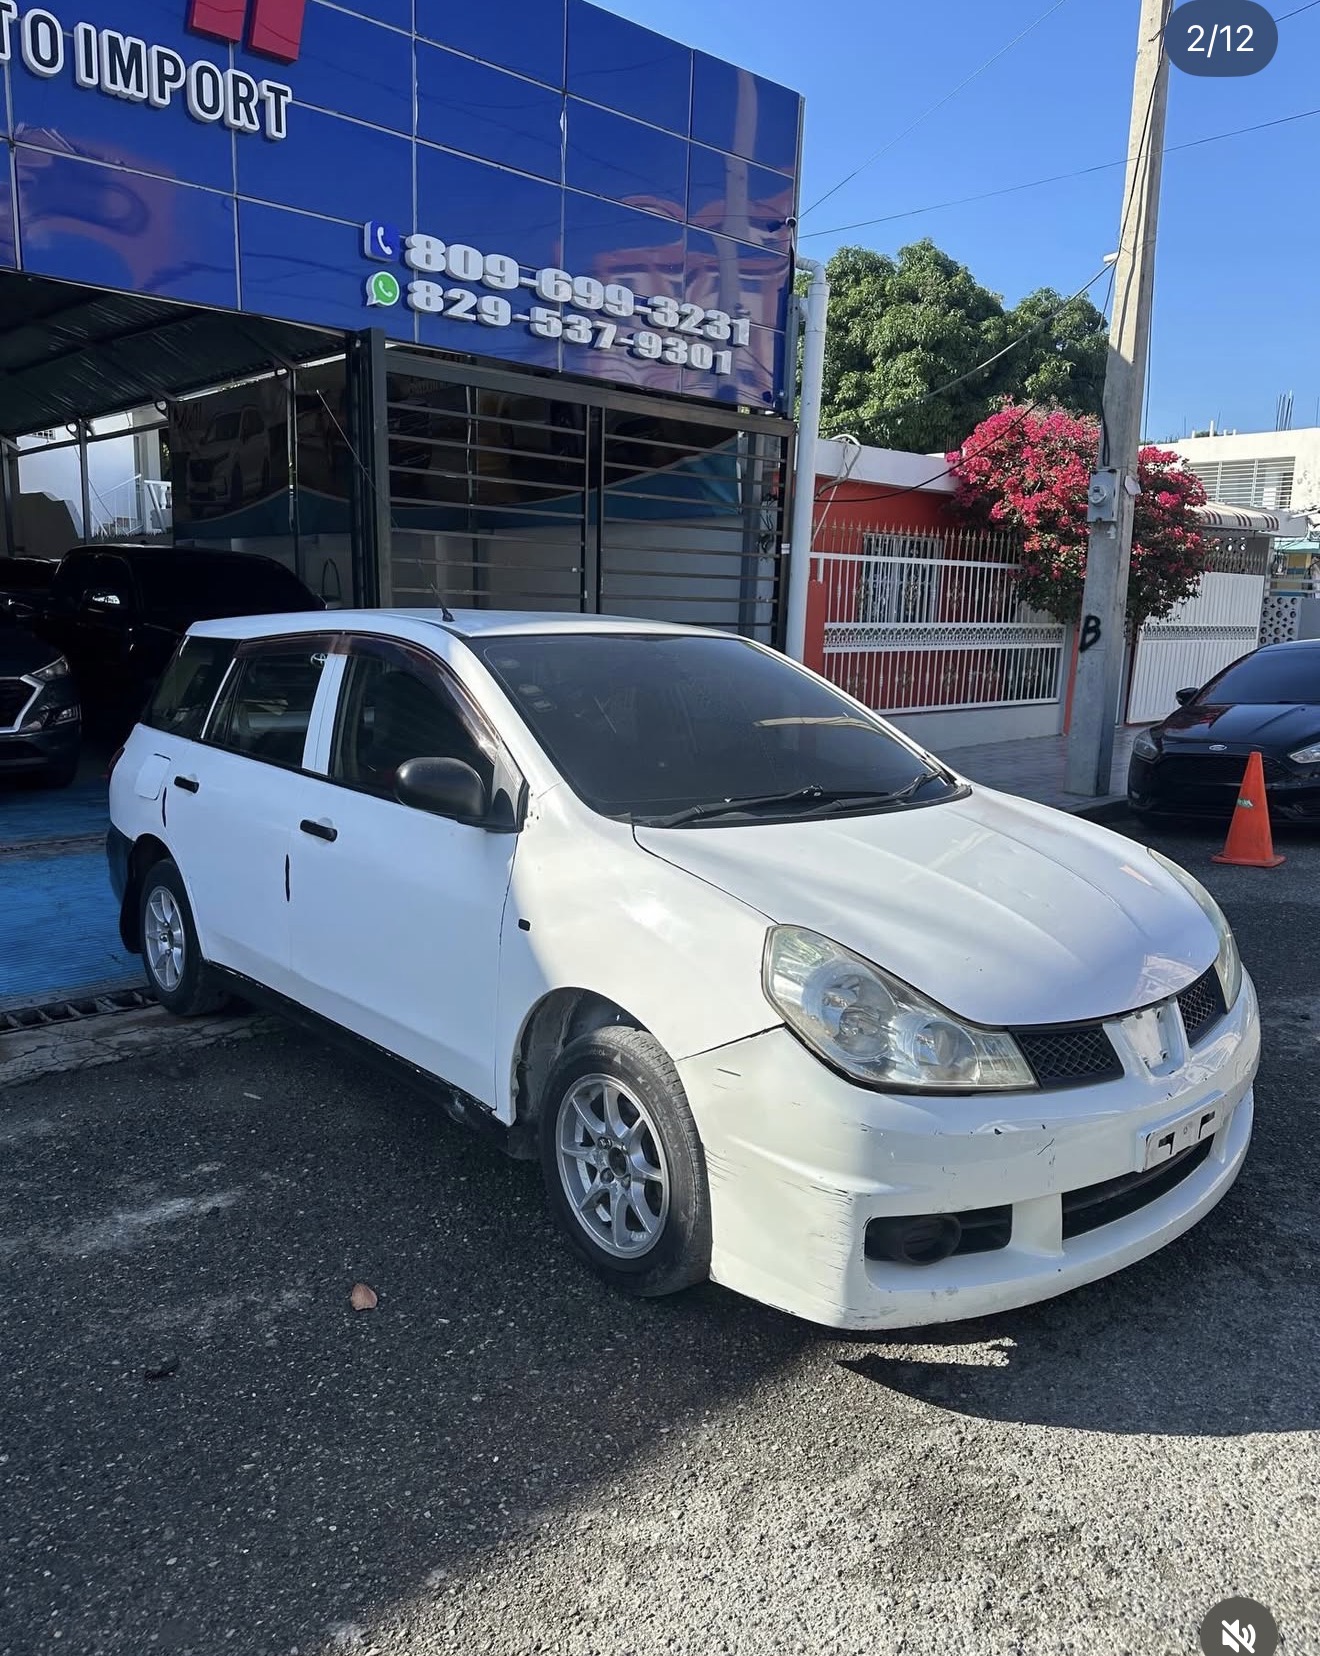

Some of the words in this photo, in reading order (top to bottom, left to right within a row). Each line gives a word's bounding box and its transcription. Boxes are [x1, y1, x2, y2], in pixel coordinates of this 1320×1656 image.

[74, 22, 292, 140] IMPORT
[405, 233, 750, 347] 809-699-3231
[407, 279, 732, 376] 829-537-9301
[1080, 614, 1101, 653] B
